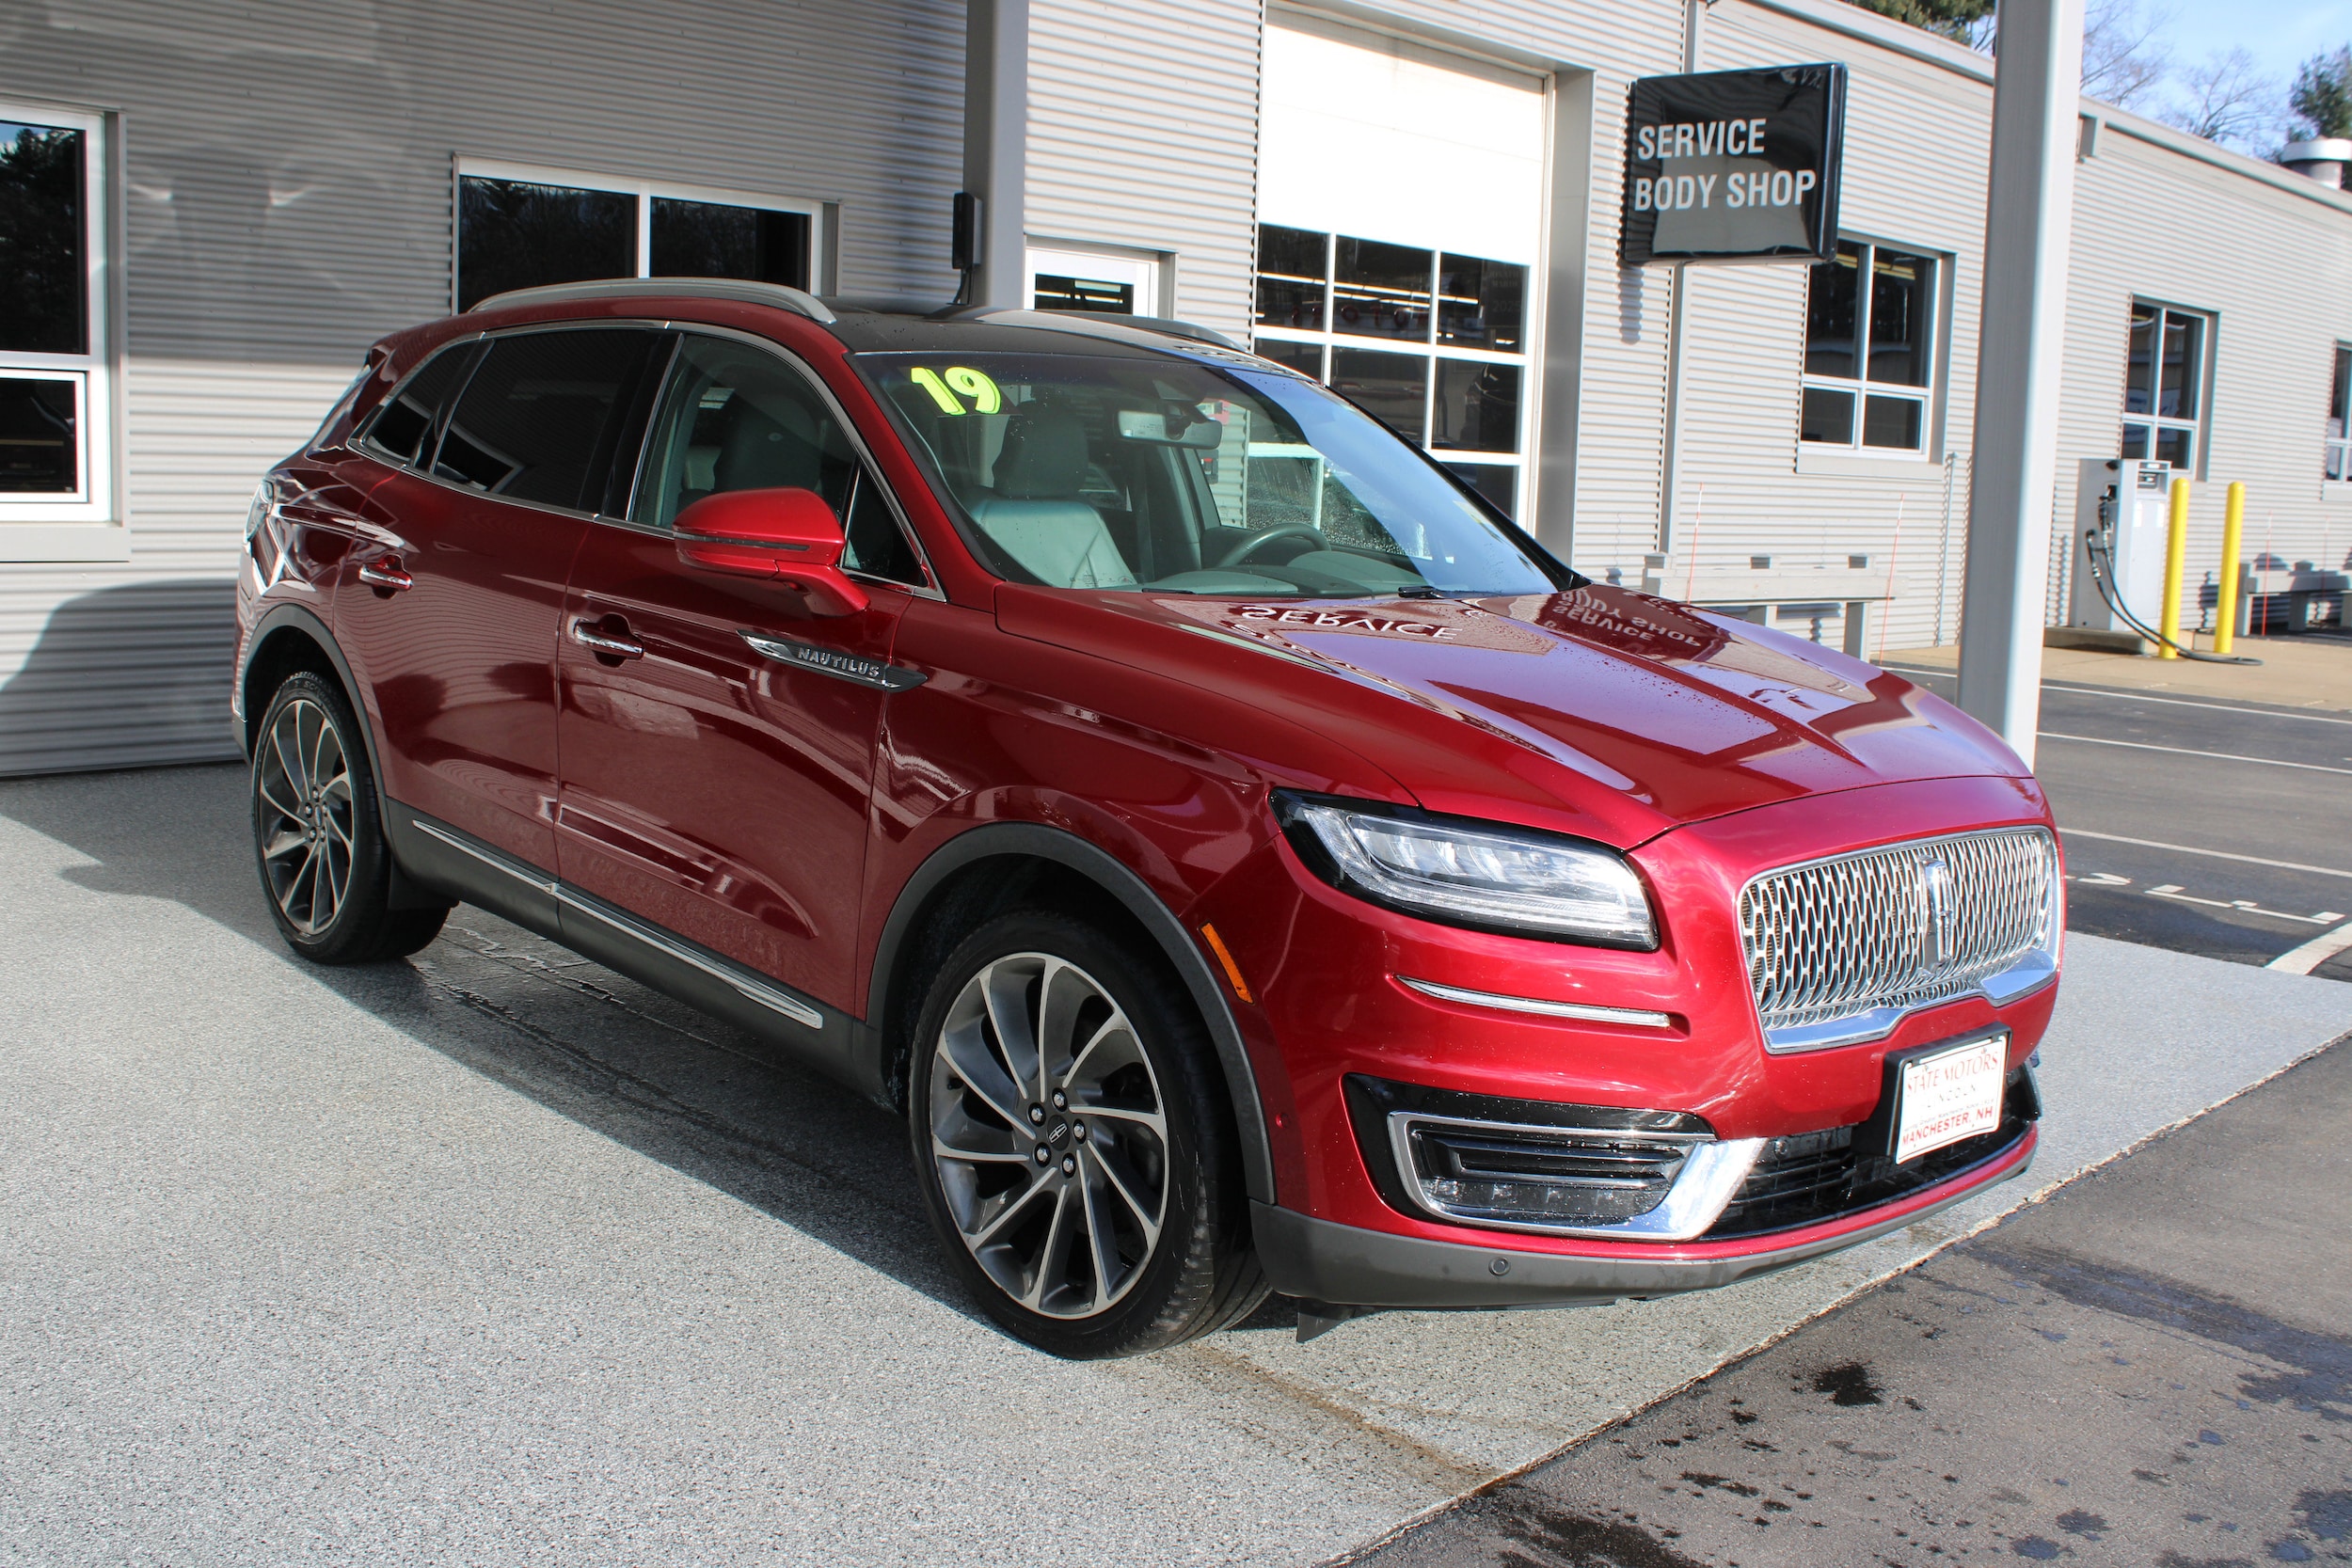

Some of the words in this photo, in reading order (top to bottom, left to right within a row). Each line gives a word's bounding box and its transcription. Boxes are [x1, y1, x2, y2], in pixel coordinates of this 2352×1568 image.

[1638, 118, 1767, 161] SERVICE
[1634, 173, 1717, 212] BODY
[1726, 169, 1817, 209] SHOP
[911, 366, 1001, 416] 19
[798, 647, 880, 677] NAUTILUS
[1906, 1069, 1940, 1097] STATE
[1944, 1051, 1998, 1082] MOTORS
[1976, 1105, 1994, 1121] NH
